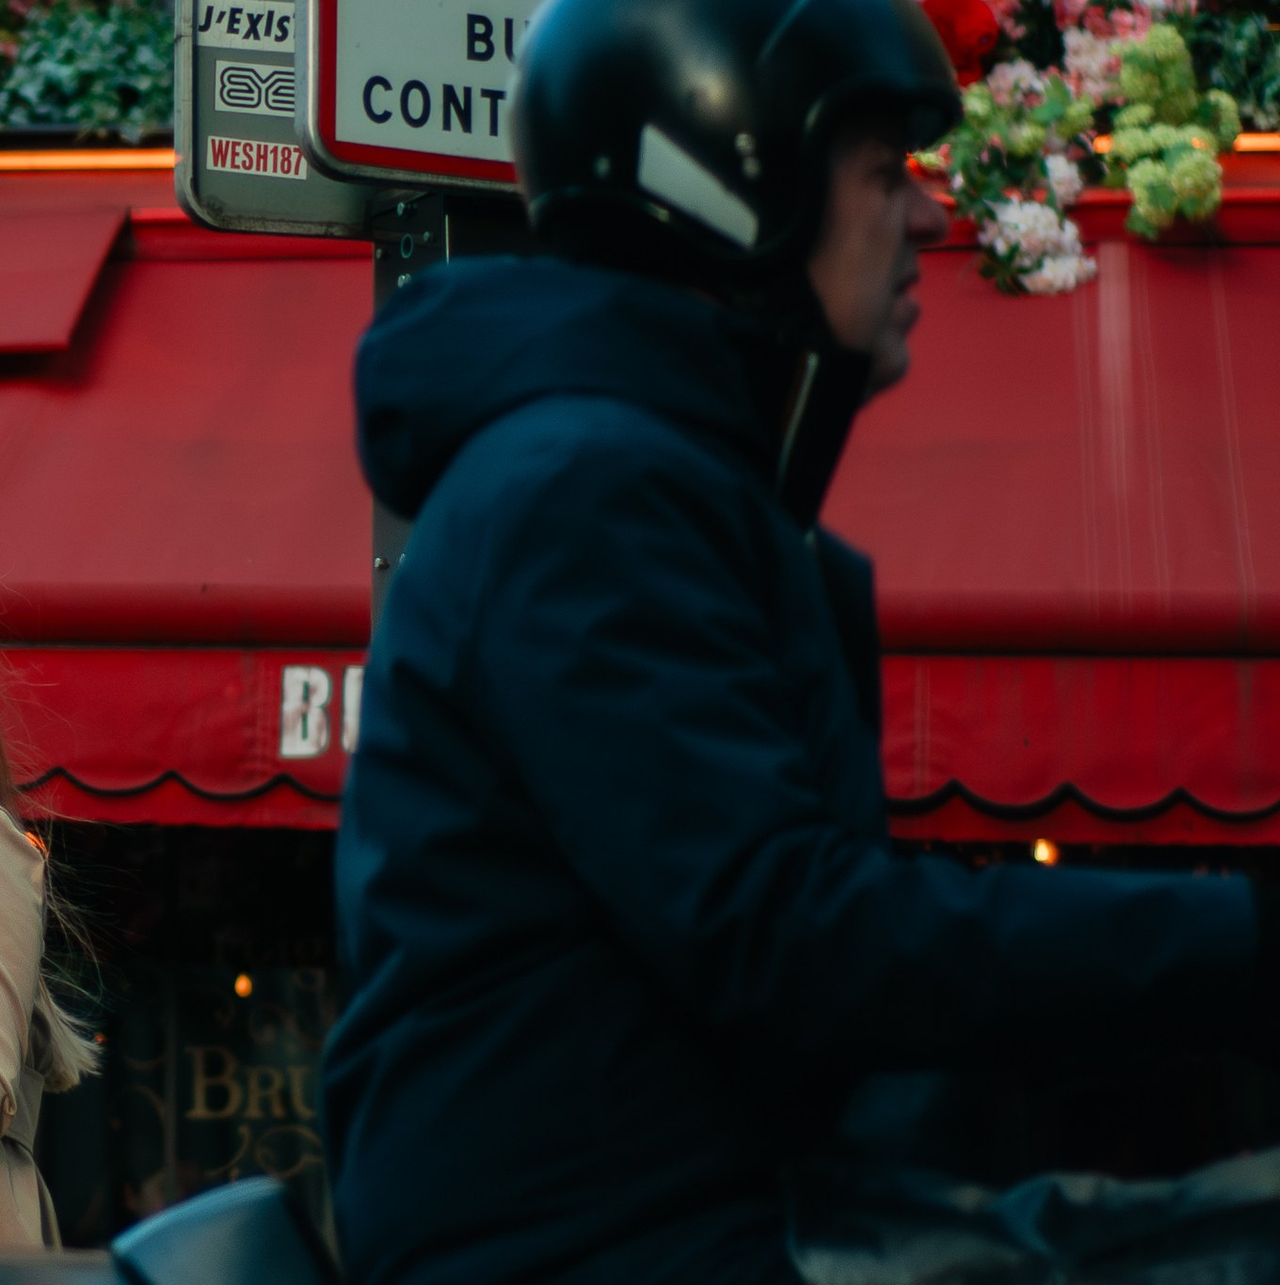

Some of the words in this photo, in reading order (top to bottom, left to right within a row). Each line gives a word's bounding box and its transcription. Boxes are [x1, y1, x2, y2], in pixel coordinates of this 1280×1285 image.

[198, 5, 296, 43] J'EXIS
[362, 75, 507, 137] CONT
[210, 138, 303, 176] WESH187
